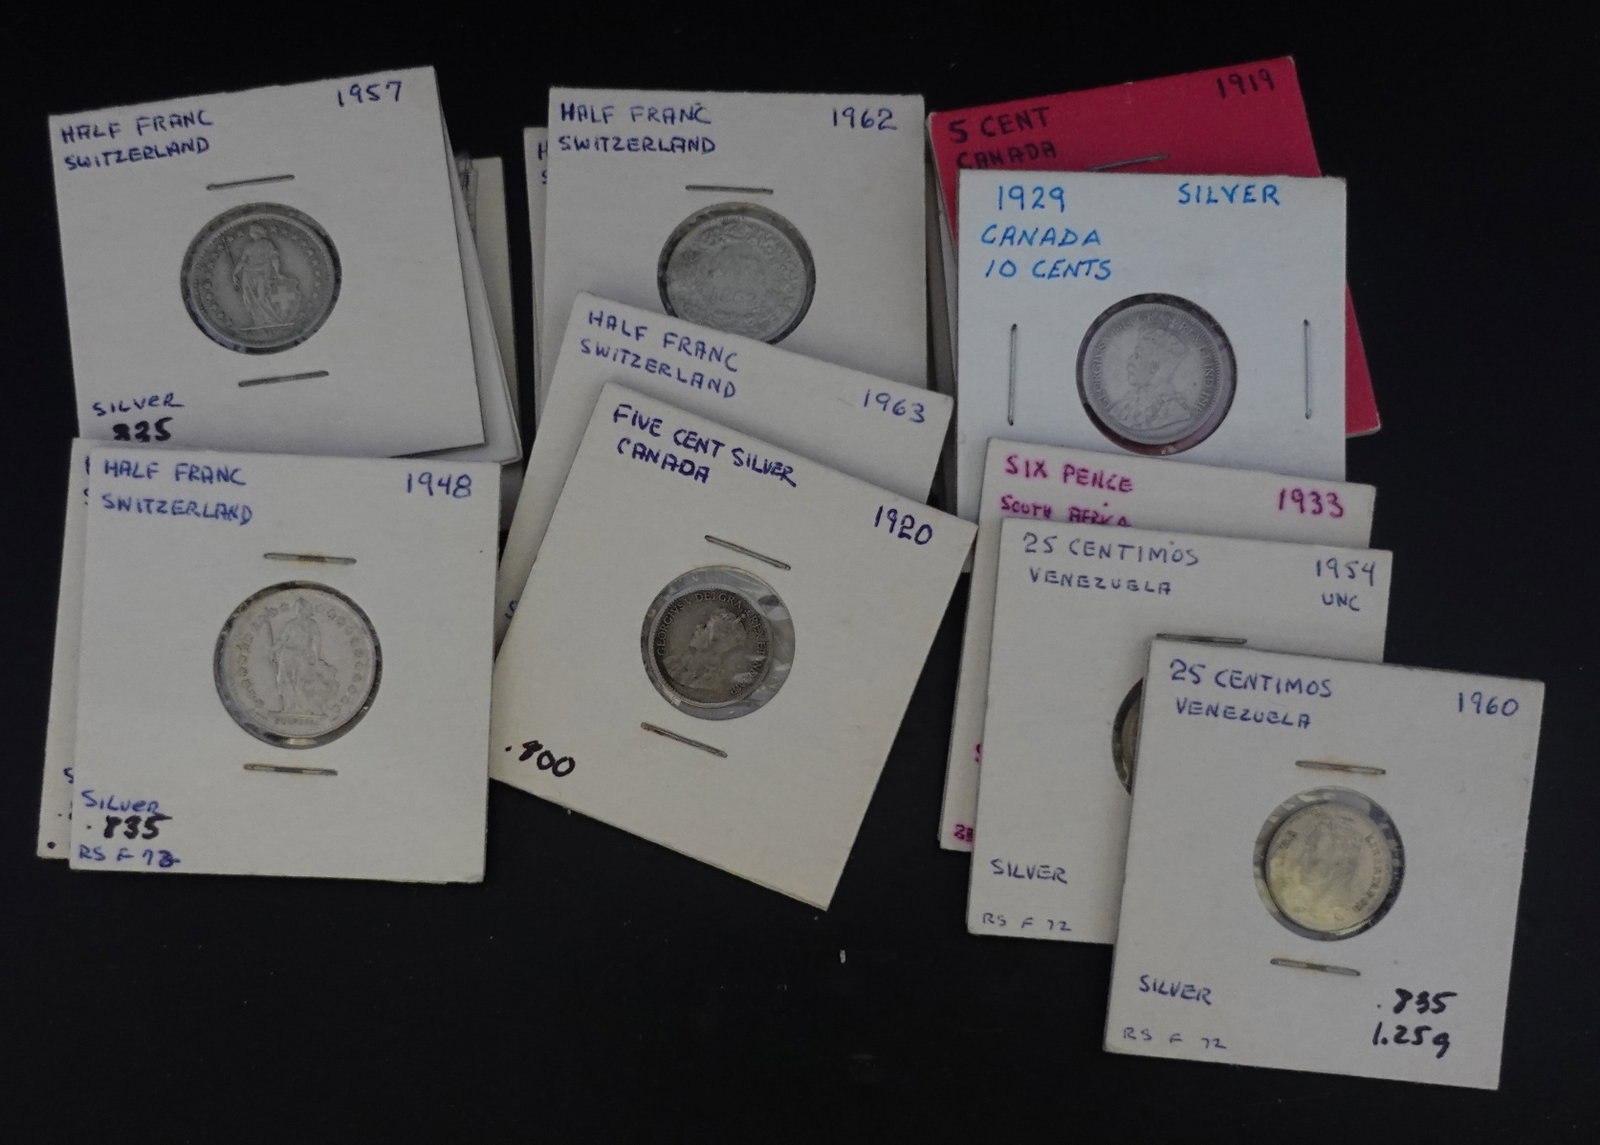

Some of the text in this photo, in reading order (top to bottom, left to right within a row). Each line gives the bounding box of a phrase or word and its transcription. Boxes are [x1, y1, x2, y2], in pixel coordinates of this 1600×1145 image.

[338, 81, 402, 107] 1957
[1216, 69, 1276, 98] 1919
[61, 110, 214, 144] HALF FRANC
[560, 103, 712, 125] HALF FRANC
[832, 107, 898, 131] 1962
[949, 106, 1050, 144] 5 CENT
[64, 137, 210, 171] SWITZERLAND
[558, 136, 716, 155] SWITZERLAND
[956, 141, 1057, 169] CANADA
[997, 186, 1066, 213] 1929
[1178, 183, 1280, 206] SILVER
[981, 225, 1101, 247] CANADA
[985, 259, 1112, 280] 10 CENTS
[588, 311, 739, 373] HALF FRANC
[580, 338, 737, 398] SWITZERLAND
[864, 389, 926, 423] 1963
[613, 404, 796, 488] FIVE CENT SILVER
[104, 459, 159, 479] HALF
[175, 462, 247, 486] FRANC
[617, 438, 711, 483] CANADA
[1005, 455, 1134, 492] SIX PENCE
[406, 472, 473, 498] 1948
[1000, 494, 1052, 521] SOUTH
[1278, 488, 1345, 519] 1933
[874, 506, 933, 545] 1920
[1023, 532, 1200, 566] 25 CENTIMOS
[1029, 566, 1172, 596] VENEZUELA
[1315, 558, 1376, 587] 1954
[1321, 592, 1361, 613] UNC
[1170, 660, 1333, 698] 25 CENTIMOS
[1176, 697, 1311, 729] VENEZUELA
[1458, 692, 1519, 717] 1960
[79, 844, 106, 862] RS
[991, 859, 1068, 884] SILVER
[982, 913, 1071, 931] RS F 72
[1139, 974, 1212, 1005] SILVER
[1123, 1027, 1227, 1049] RS F 72
